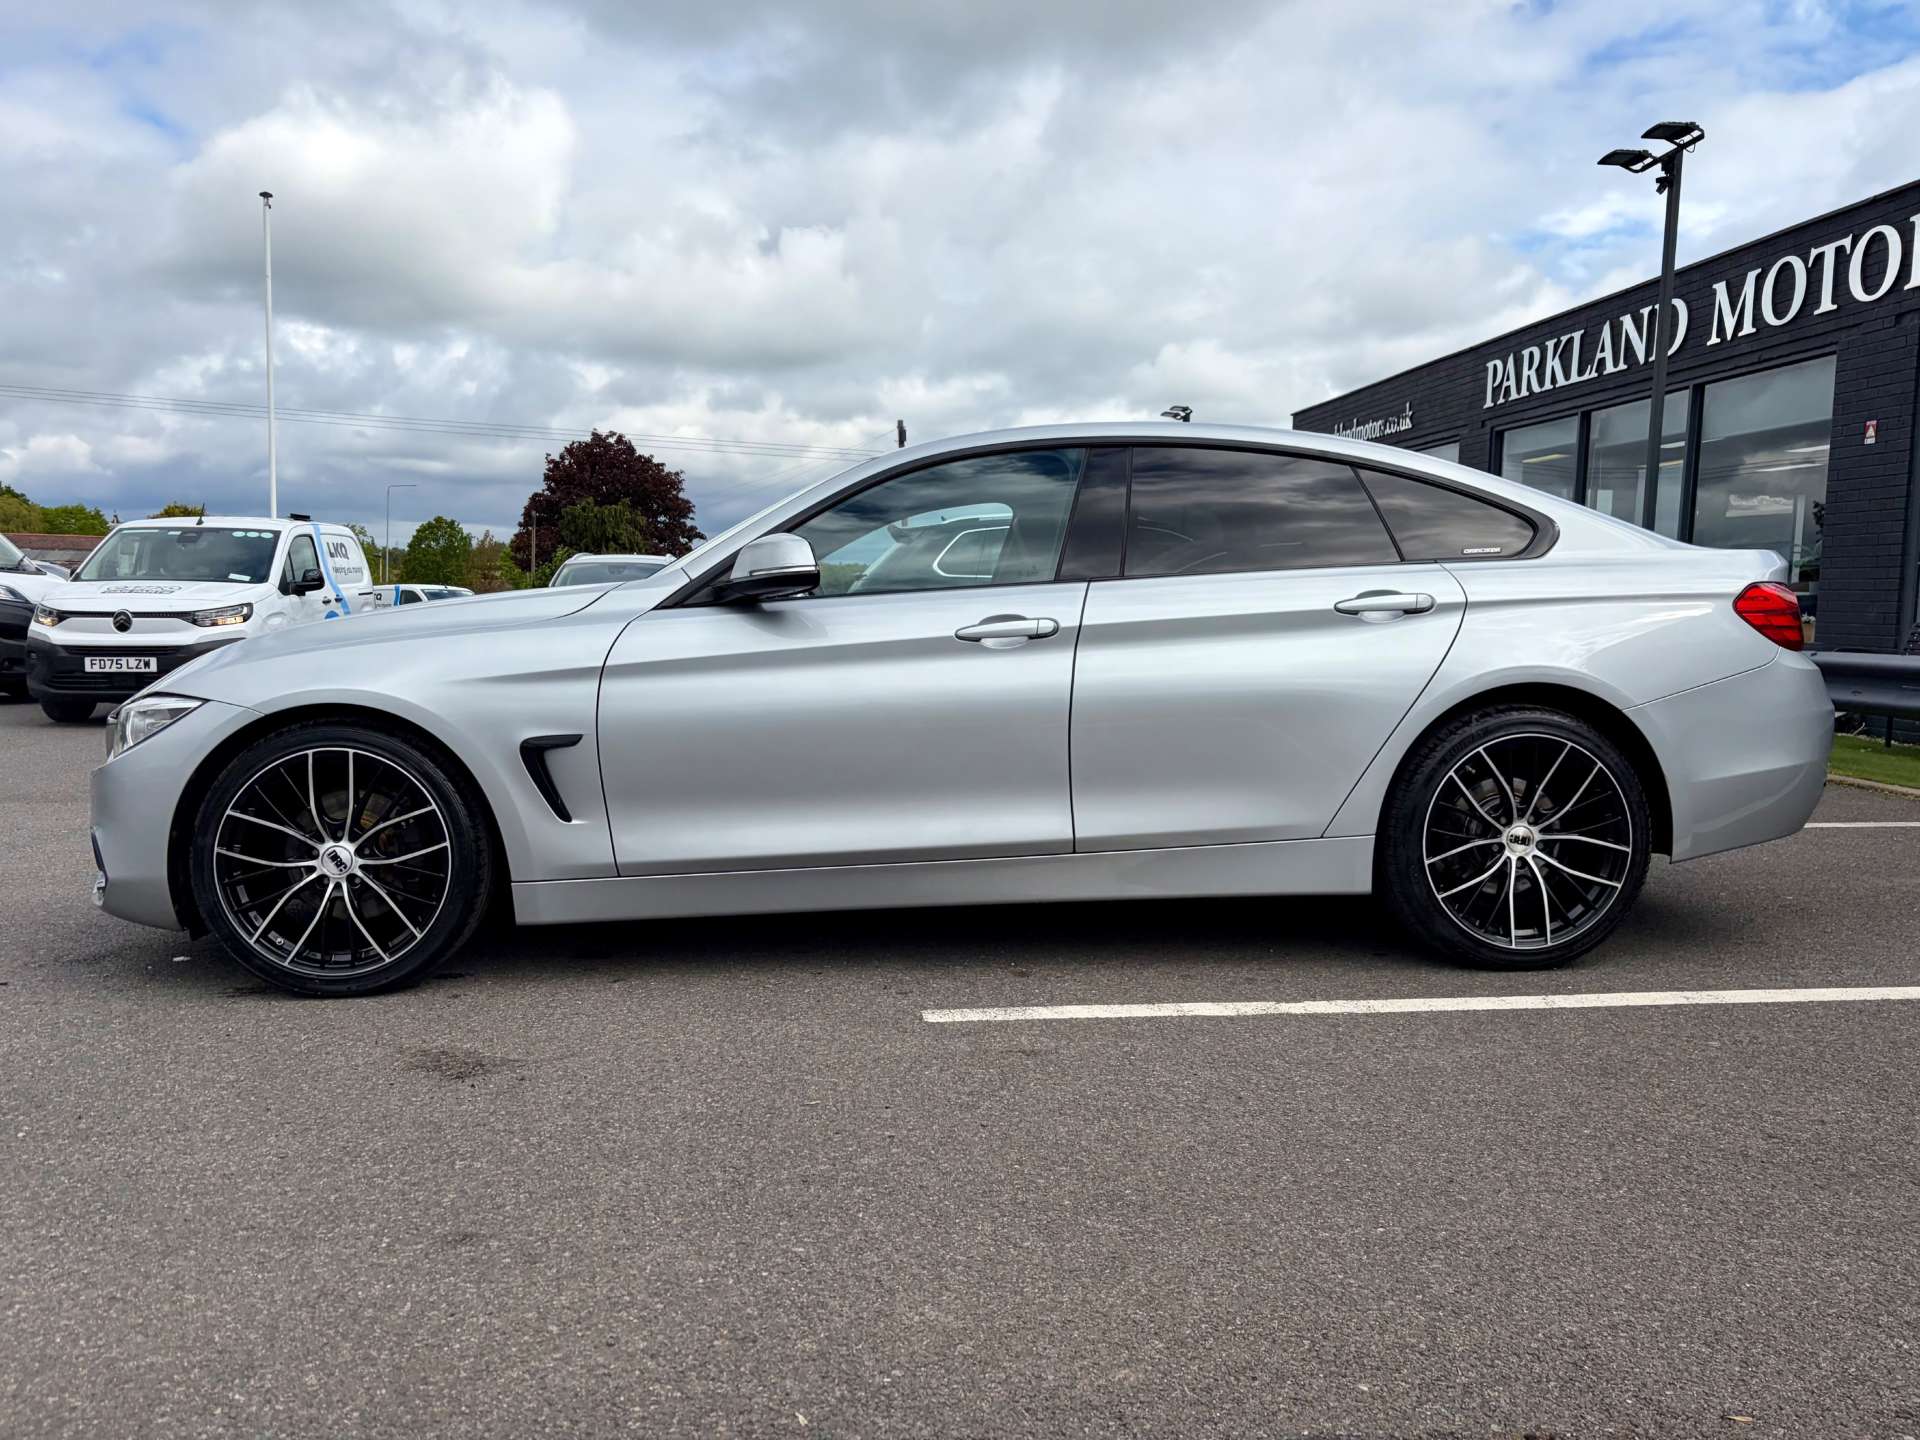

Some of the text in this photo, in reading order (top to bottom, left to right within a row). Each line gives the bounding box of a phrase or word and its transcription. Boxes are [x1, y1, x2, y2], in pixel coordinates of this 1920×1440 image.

[1483, 298, 1689, 409] PARKLAND
[1334, 401, 1413, 440] klandmotors.co.uk
[326, 541, 350, 560] LKQ
[90, 658, 151, 670] FD75 LZW
